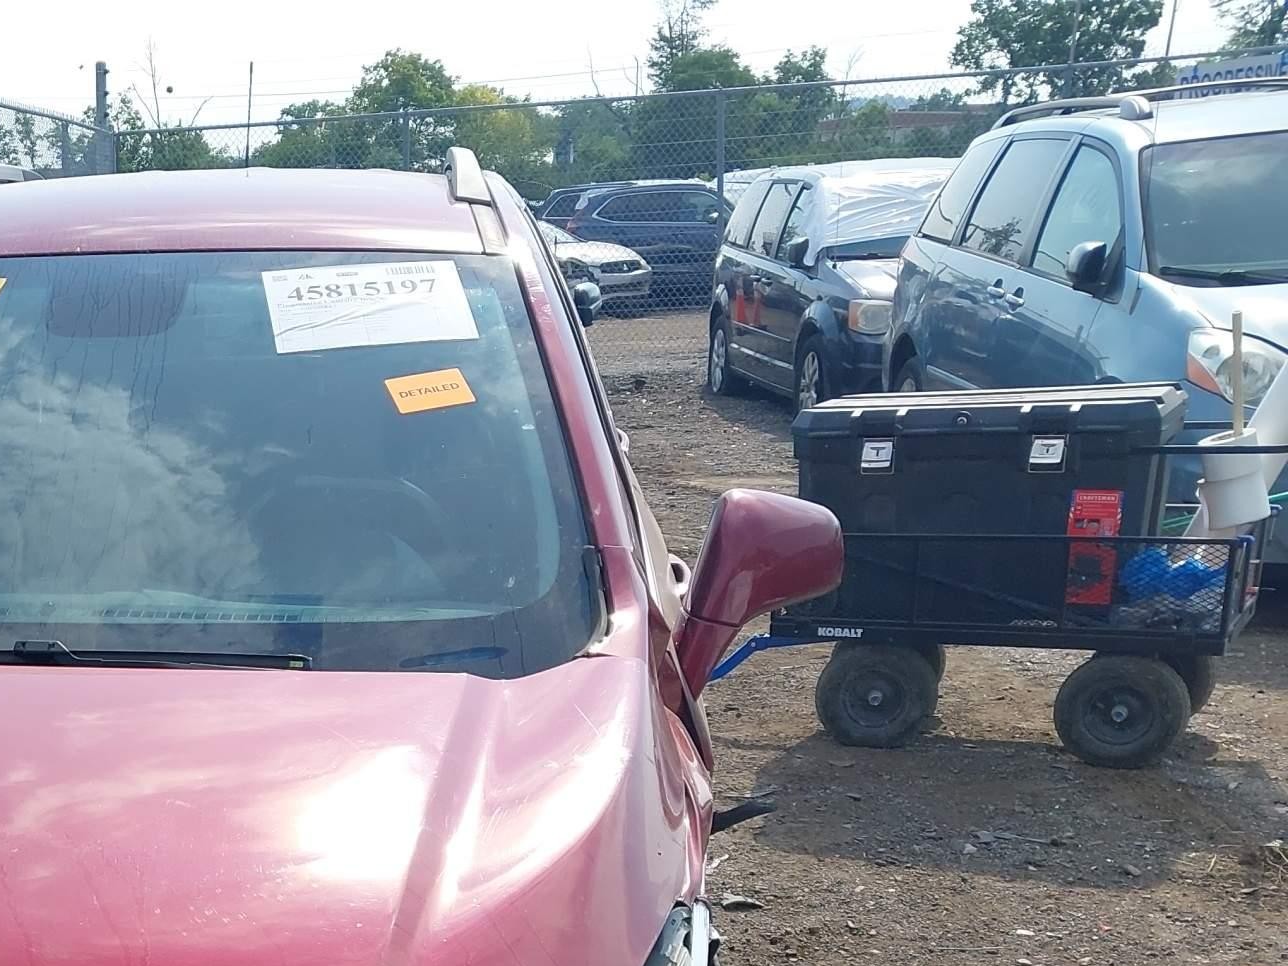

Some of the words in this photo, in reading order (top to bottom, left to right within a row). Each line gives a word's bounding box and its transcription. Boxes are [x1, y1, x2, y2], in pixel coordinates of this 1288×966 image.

[287, 278, 436, 301] 45815197
[399, 382, 460, 398] DETAILED
[818, 626, 863, 638] KOBALT
